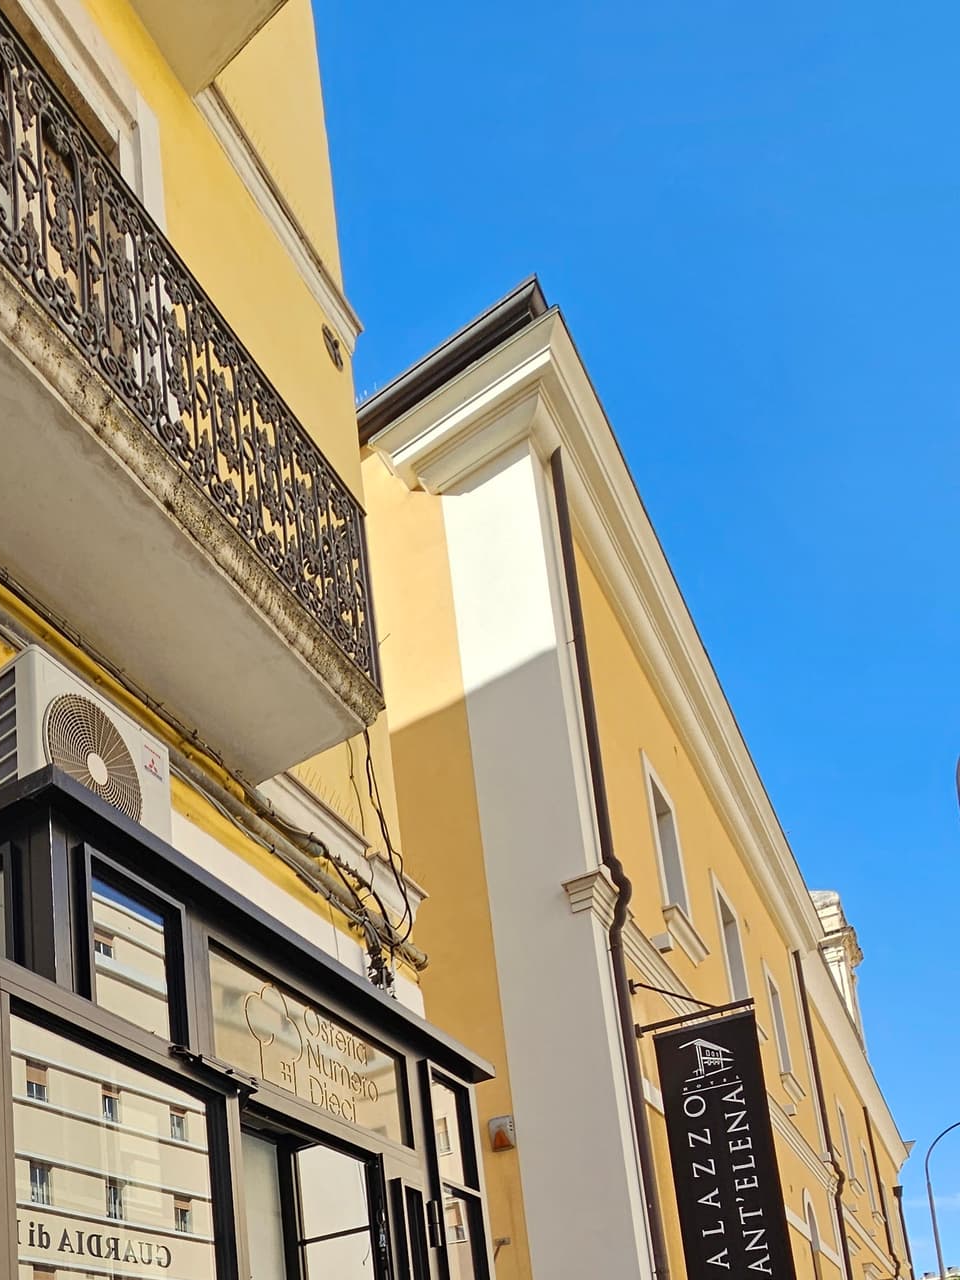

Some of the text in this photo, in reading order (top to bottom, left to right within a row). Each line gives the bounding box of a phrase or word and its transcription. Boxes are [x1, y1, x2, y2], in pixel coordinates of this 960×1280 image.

[303, 1006, 369, 1067] Osteria
[306, 1039, 379, 1103] Numero
[309, 1075, 357, 1124] Dieci
